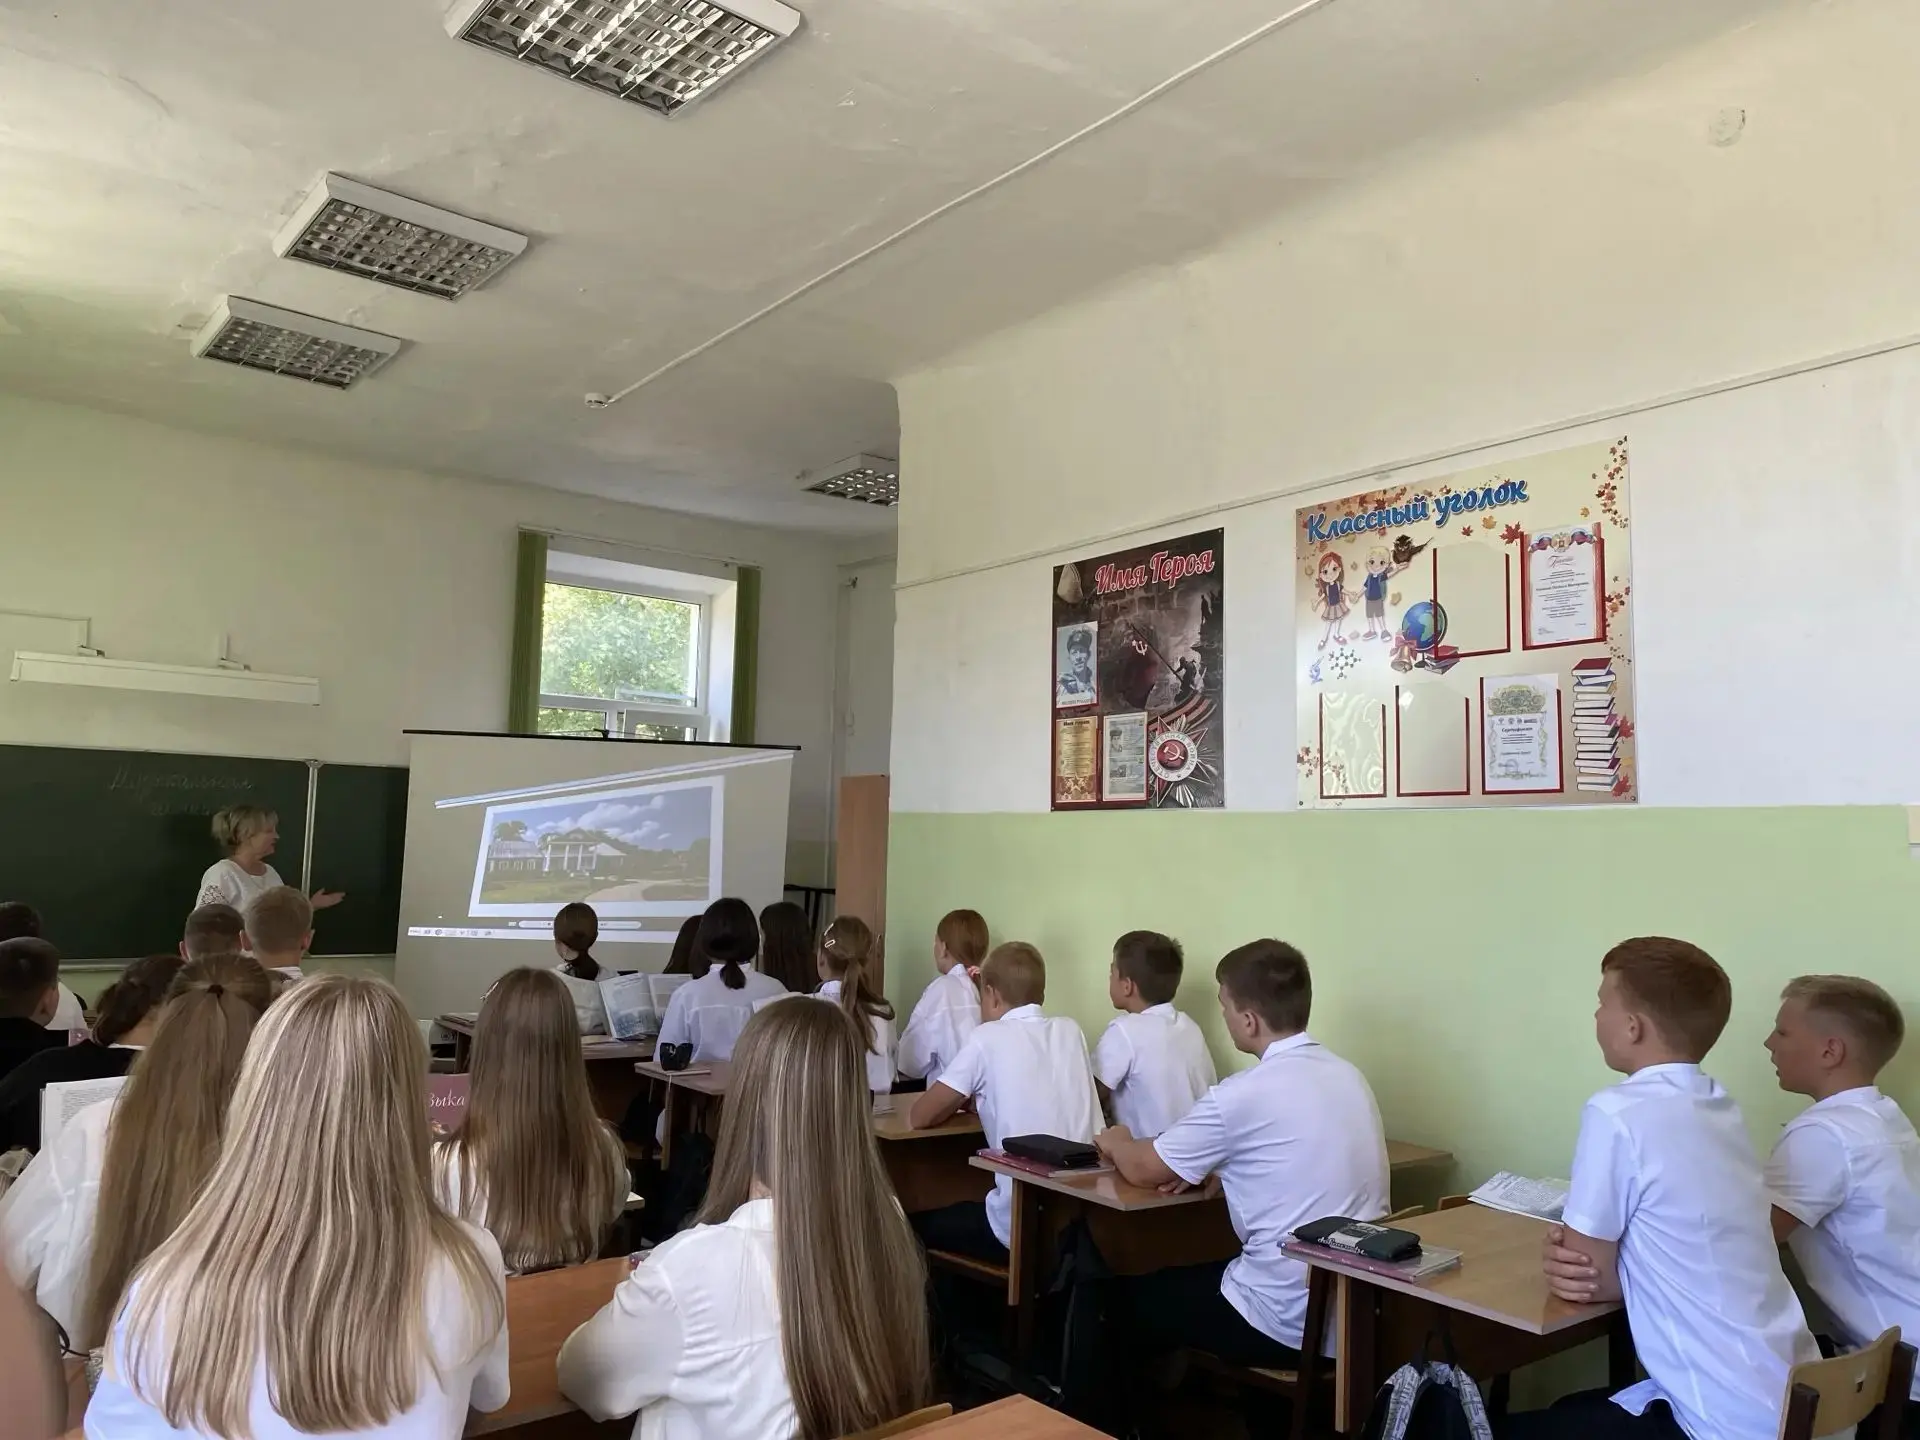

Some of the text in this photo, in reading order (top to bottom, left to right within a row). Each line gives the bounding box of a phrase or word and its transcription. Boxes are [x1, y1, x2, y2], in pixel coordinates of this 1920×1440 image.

[1306, 480, 1530, 544] Классный уголок
[1095, 549, 1216, 595] Имя Героя
[430, 1088, 466, 1108] зыка
